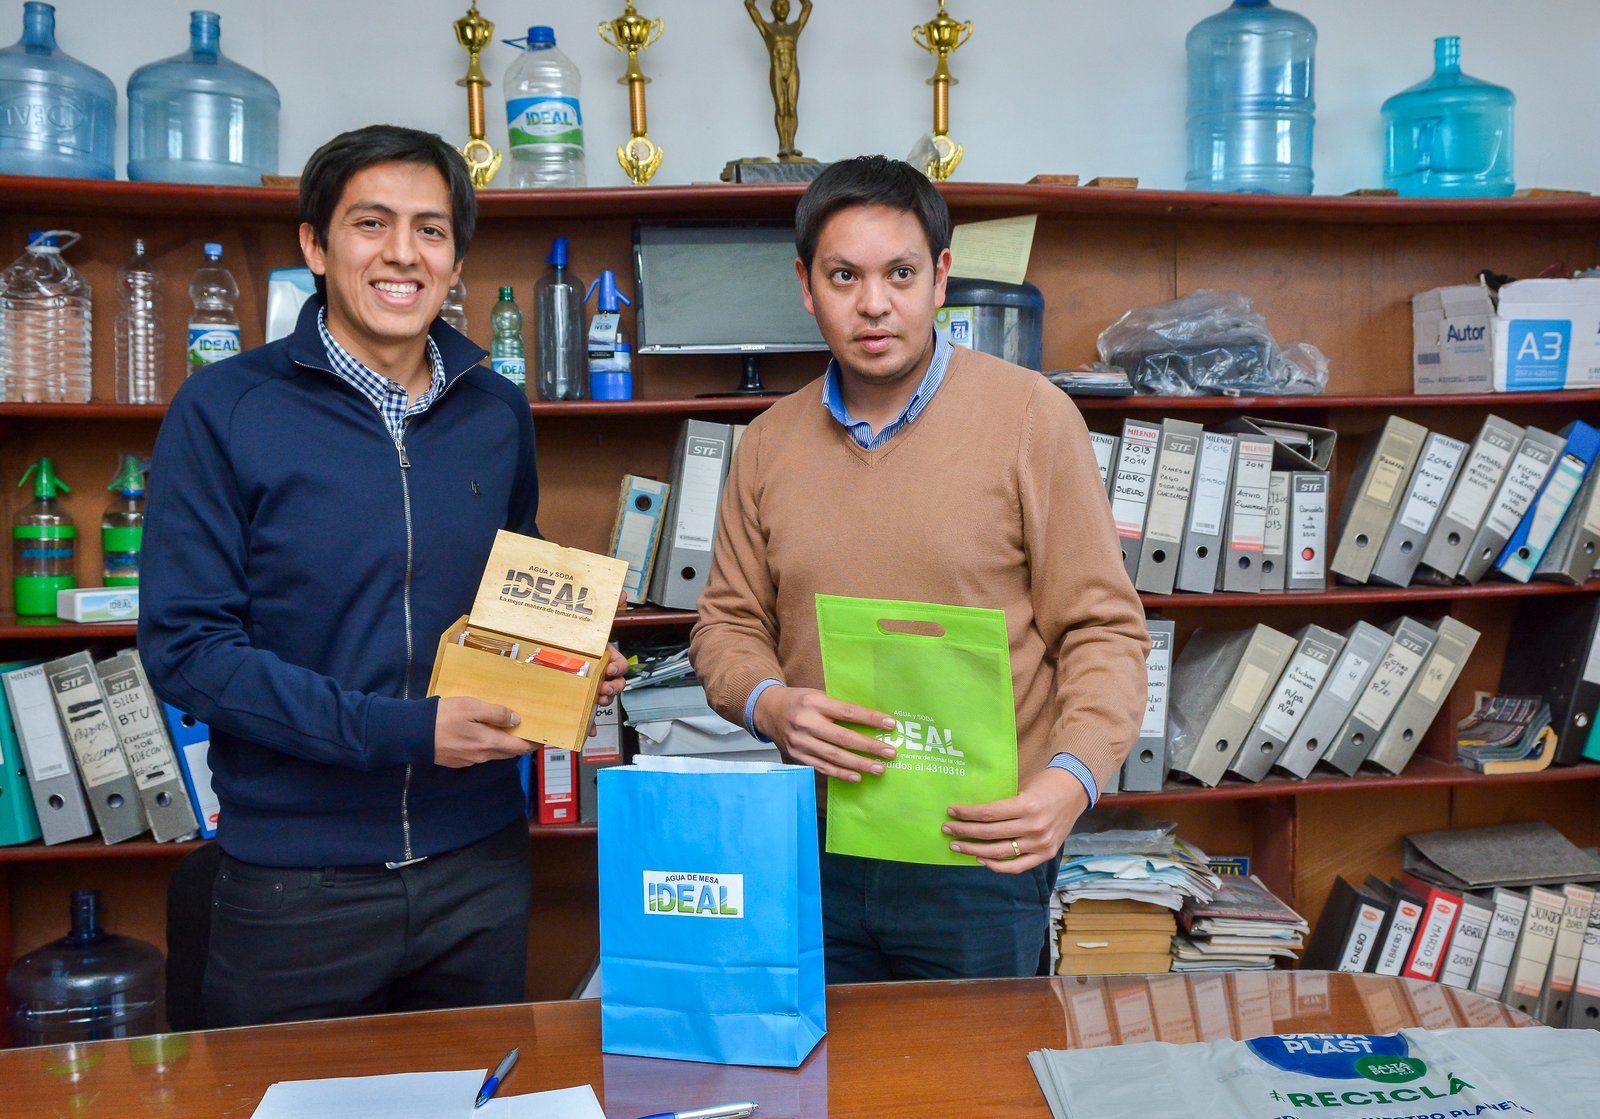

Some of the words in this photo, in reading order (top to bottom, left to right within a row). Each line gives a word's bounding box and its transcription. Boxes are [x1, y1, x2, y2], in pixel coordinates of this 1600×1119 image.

[525, 111, 573, 126] IDEAL
[1447, 324, 1485, 342] Autor
[199, 339, 238, 351] IDEAL
[1516, 331, 1562, 361] A3
[1090, 435, 1113, 445] ILENIO
[1128, 428, 1157, 439] MILENIO
[1206, 435, 1232, 445] MILENIO
[693, 445, 718, 456] STF
[1126, 443, 1151, 454] 2013
[1170, 442, 1191, 453] STF
[1427, 453, 1452, 469] 2016
[1117, 473, 1146, 483] LIBRO
[1115, 486, 1144, 497] SUELDO
[1301, 483, 1322, 492] STF
[529, 566, 548, 575] AGUA
[555, 571, 574, 581] SODA
[501, 569, 593, 616] IDEAL
[109, 600, 133, 609] IDEAL
[507, 598, 524, 606] mejor
[524, 602, 546, 611] manera
[554, 609, 572, 618] tomar
[1152, 640, 1165, 648] TF
[1400, 638, 1422, 652] STF
[1304, 647, 1327, 661] STF
[10, 668, 43, 681] MILENIO
[61, 676, 86, 691] STF
[111, 678, 134, 694] STF
[118, 706, 150, 726] BTU
[595, 708, 614, 717] 016
[893, 710, 911, 719] AGUA
[917, 714, 934, 723] SODA
[876, 719, 964, 757] DEAL
[915, 763, 923, 771] al
[926, 764, 966, 777] 4310310
[665, 874, 686, 882] AGUA
[698, 875, 719, 884] MESA
[649, 882, 738, 915] IDEAL
[1496, 912, 1520, 926] MAYO
[1531, 907, 1561, 924] JUNIO
[1394, 922, 1414, 935] 2013
[1459, 923, 1484, 939] ABRIL
[1496, 927, 1516, 939] 2013
[1530, 921, 1555, 937] 2013
[1423, 923, 1442, 957] MARZO
[1350, 932, 1368, 964] ENERO
[1384, 933, 1404, 968] FEBRERO
[1453, 953, 1474, 967] 2013
[1283, 1039, 1374, 1054] PLAST
[1367, 1061, 1412, 1071] SALTA
[1371, 1064, 1409, 1076] PLAST
